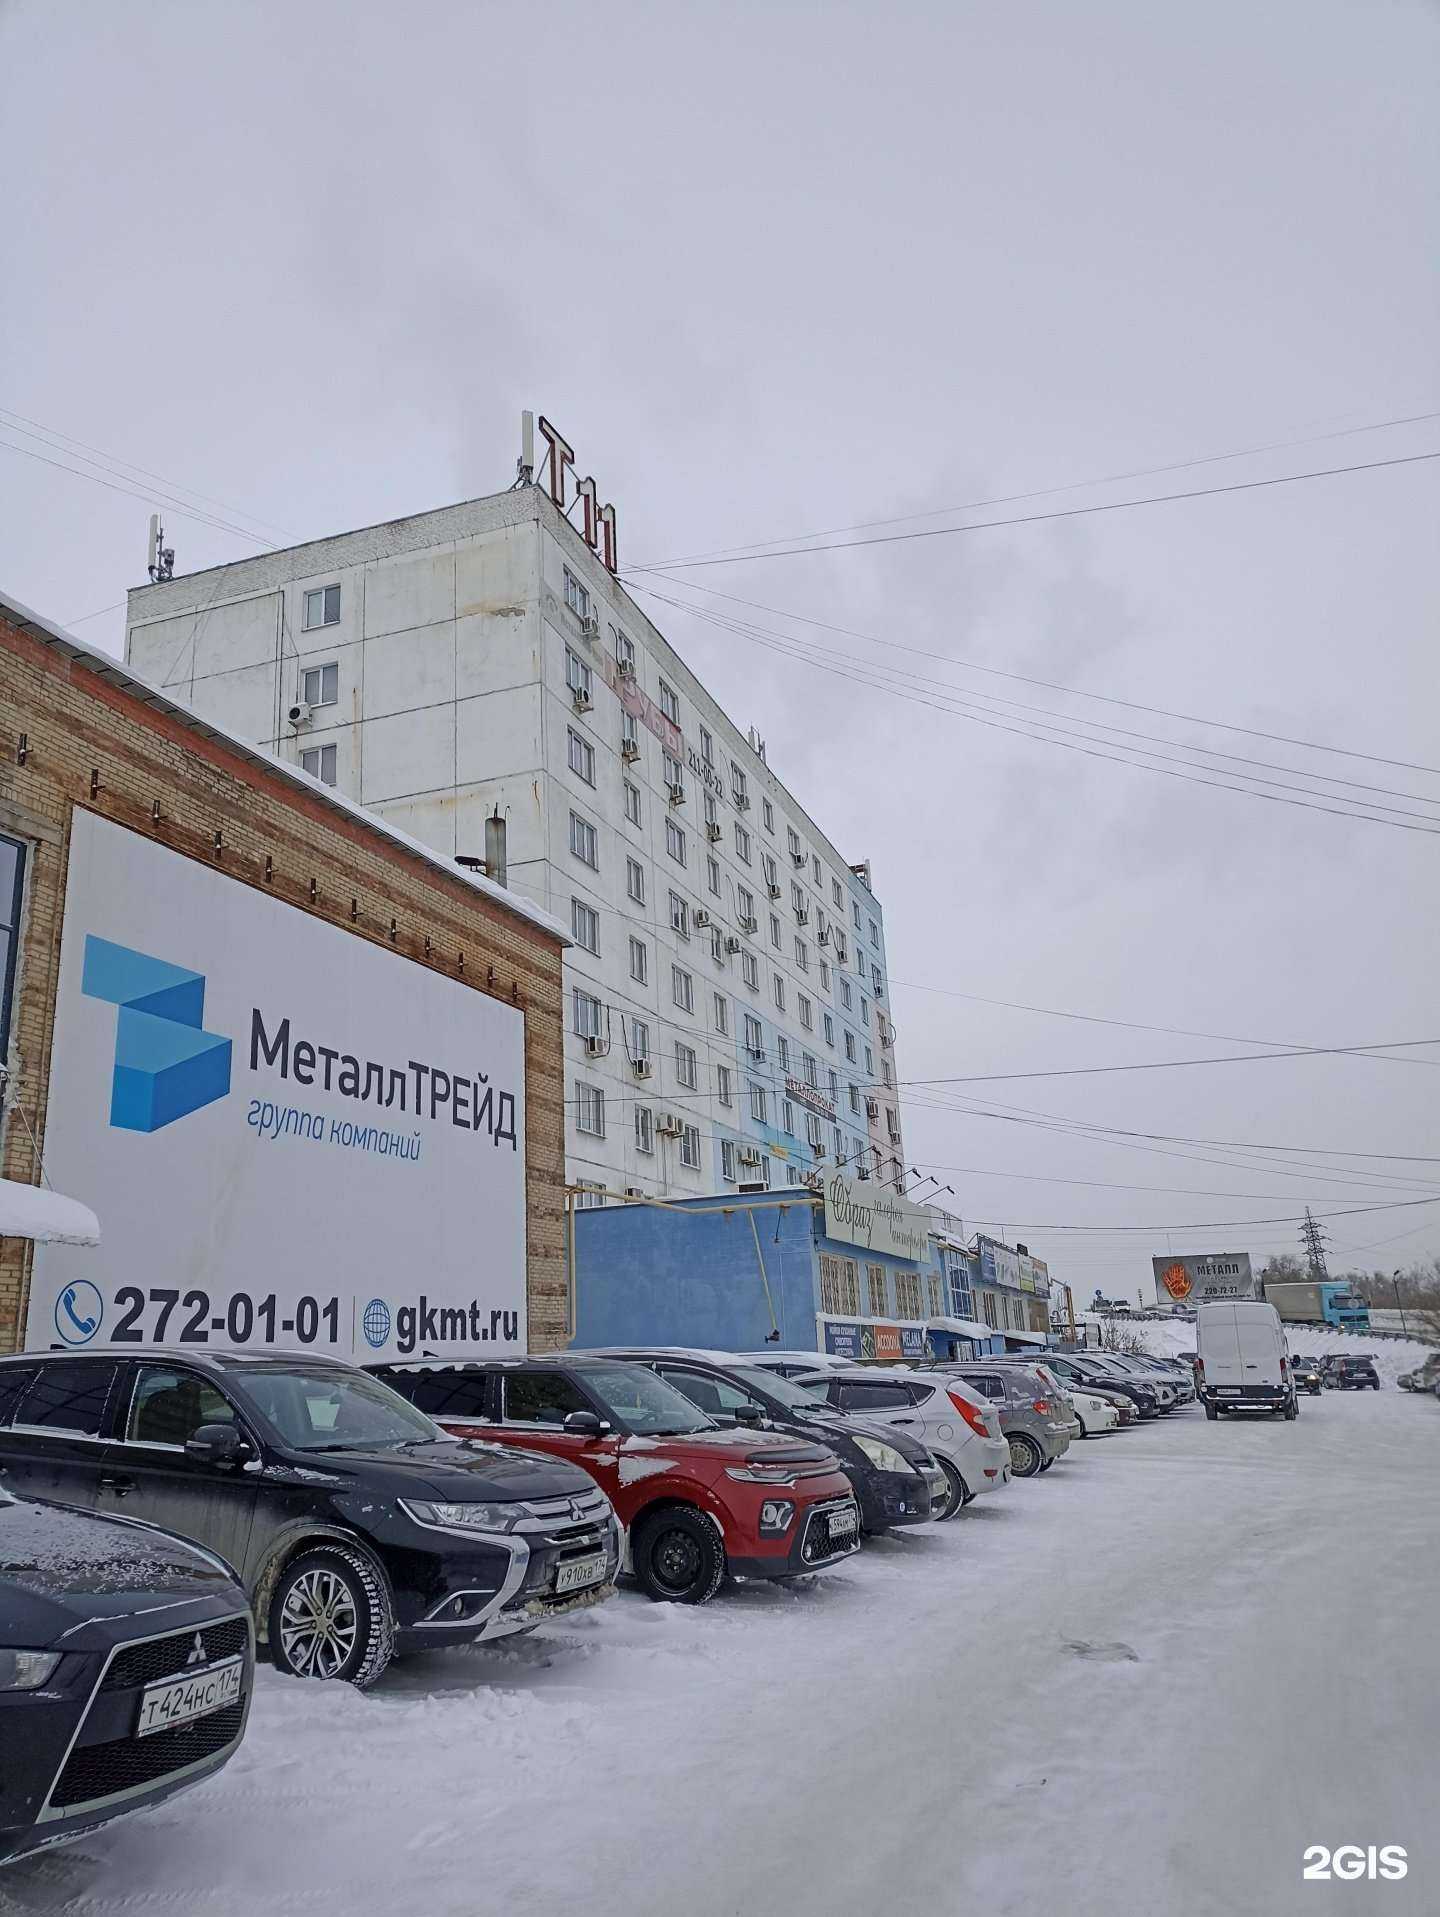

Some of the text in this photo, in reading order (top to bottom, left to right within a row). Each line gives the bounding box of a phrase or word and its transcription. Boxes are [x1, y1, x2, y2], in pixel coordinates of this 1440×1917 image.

[688, 748, 723, 798] 211-00-22
[249, 1007, 517, 1151] МеталлТРЕЙД
[247, 1100, 422, 1160] группа компаний
[1197, 1264, 1240, 1275] МЕТАЛЛ
[110, 1286, 518, 1352] 272-01-01 gkmt.ru
[148, 1666, 239, 1724] Т424НС 174
